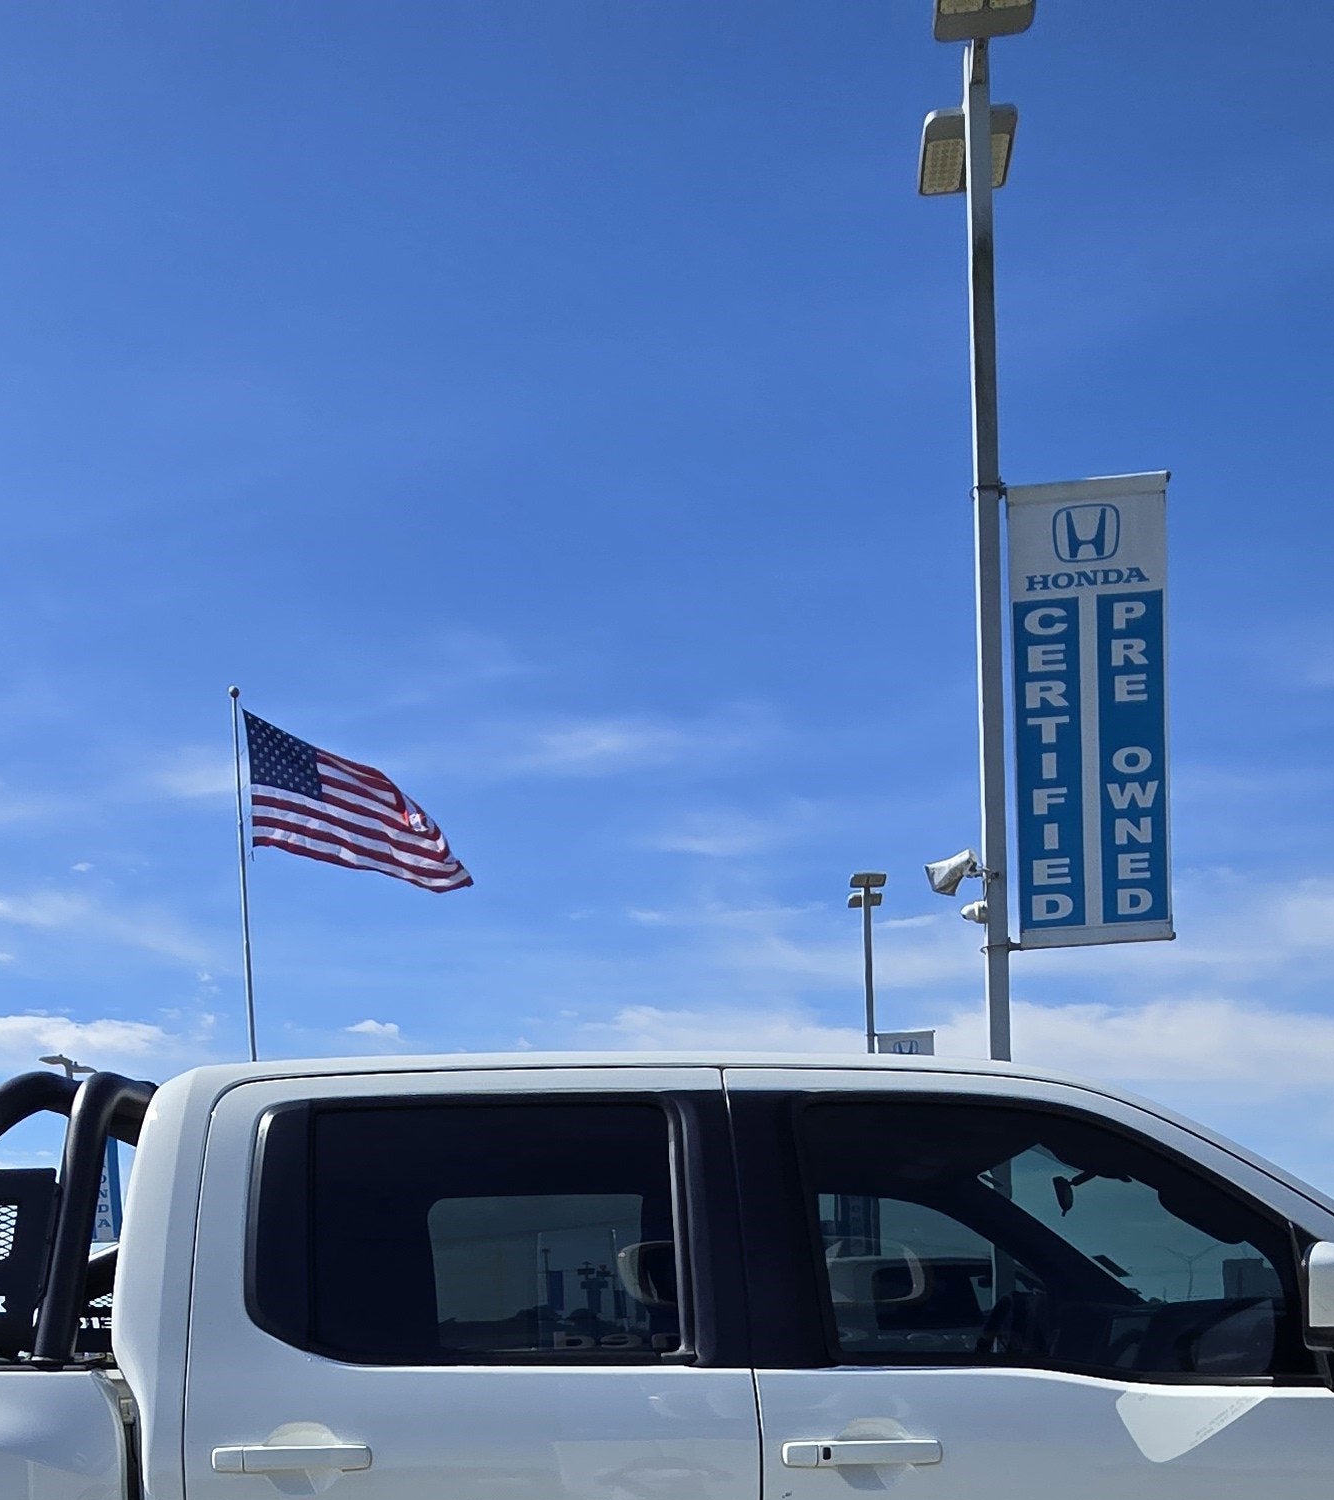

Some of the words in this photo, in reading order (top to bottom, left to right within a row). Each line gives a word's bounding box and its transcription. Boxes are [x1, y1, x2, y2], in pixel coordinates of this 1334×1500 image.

[1026, 566, 1150, 591] HONDA
[1110, 600, 1149, 702] PRE
[1023, 606, 1074, 922] CERTIFIED
[1106, 745, 1159, 915] OWNED
